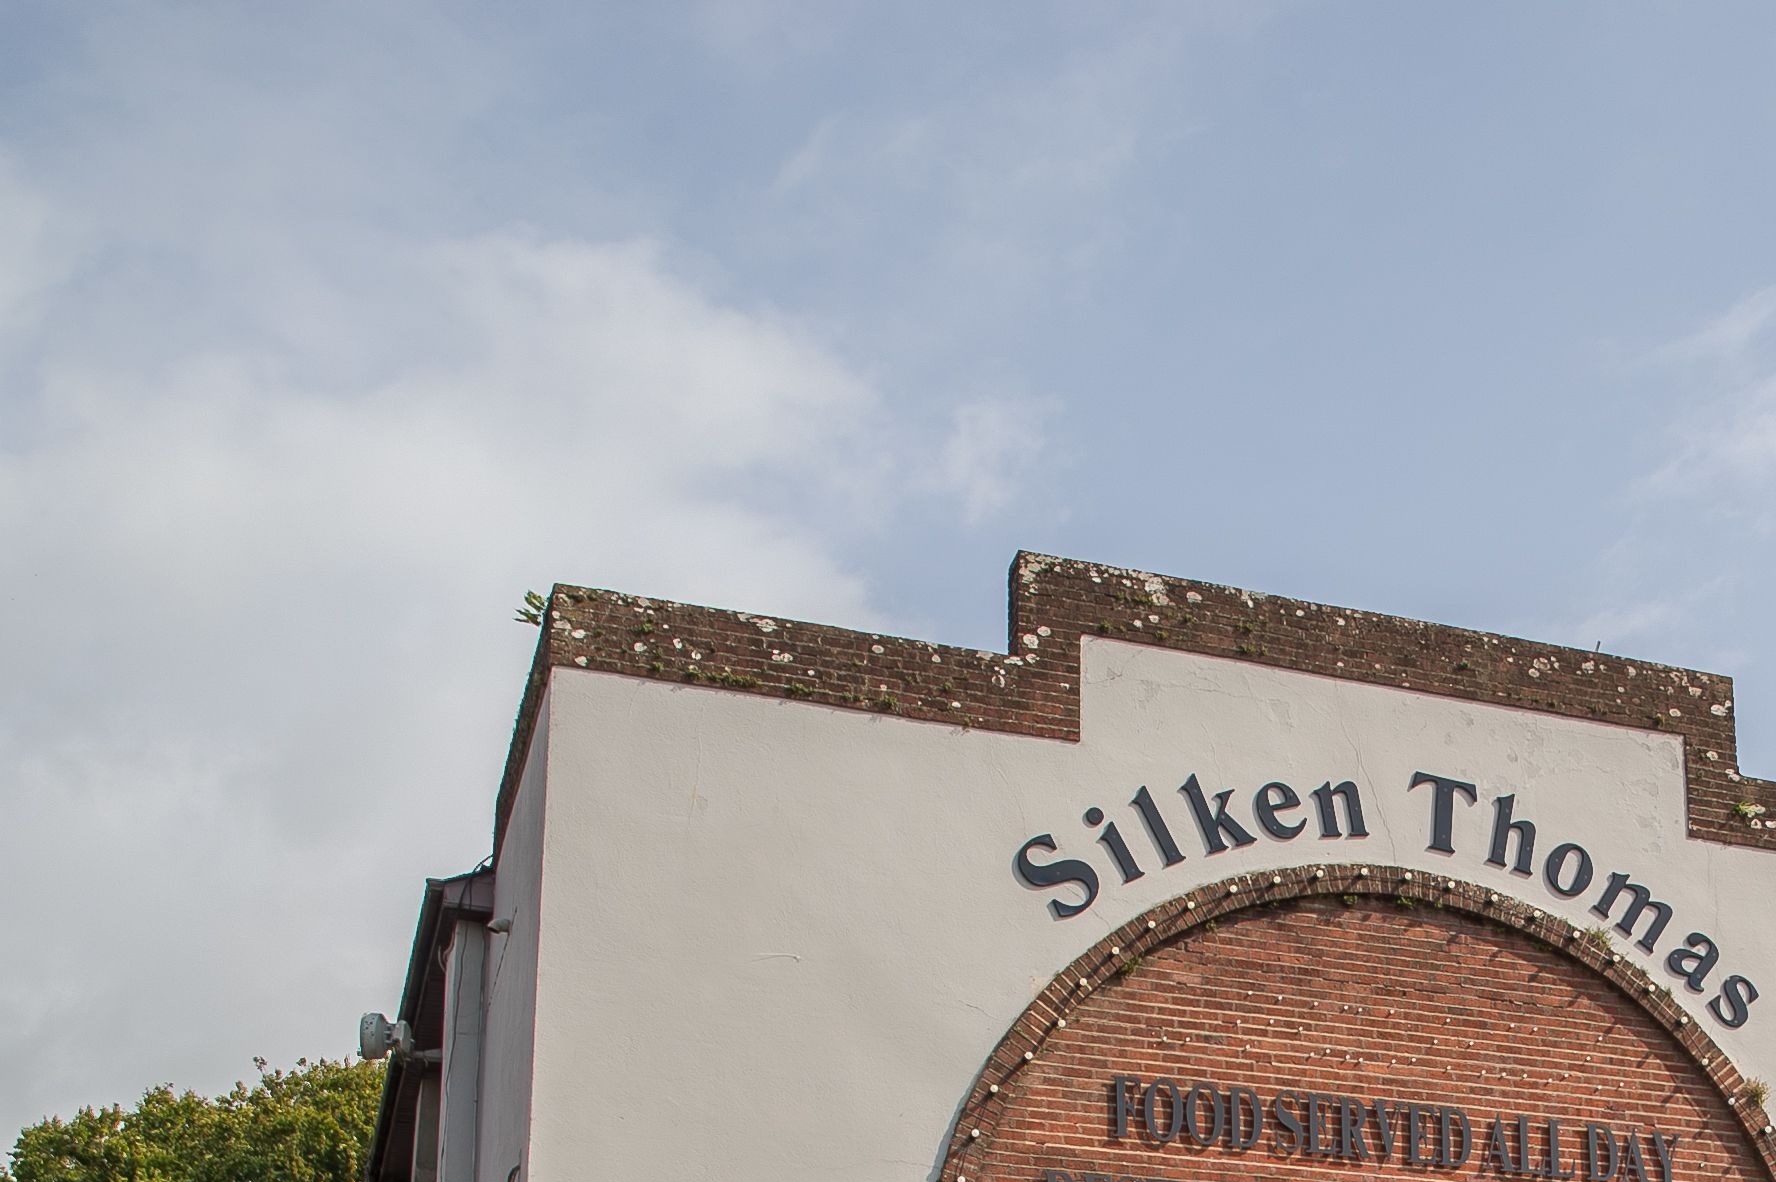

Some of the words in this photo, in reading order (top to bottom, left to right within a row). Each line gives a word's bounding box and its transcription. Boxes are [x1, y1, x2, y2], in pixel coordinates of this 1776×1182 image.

[1013, 773, 1369, 919] Silken
[1408, 771, 1760, 1029] Thomas
[1112, 1075, 1264, 1149] FOOD
[1275, 1088, 1472, 1169] SERVED
[1485, 1113, 1576, 1178] ALL
